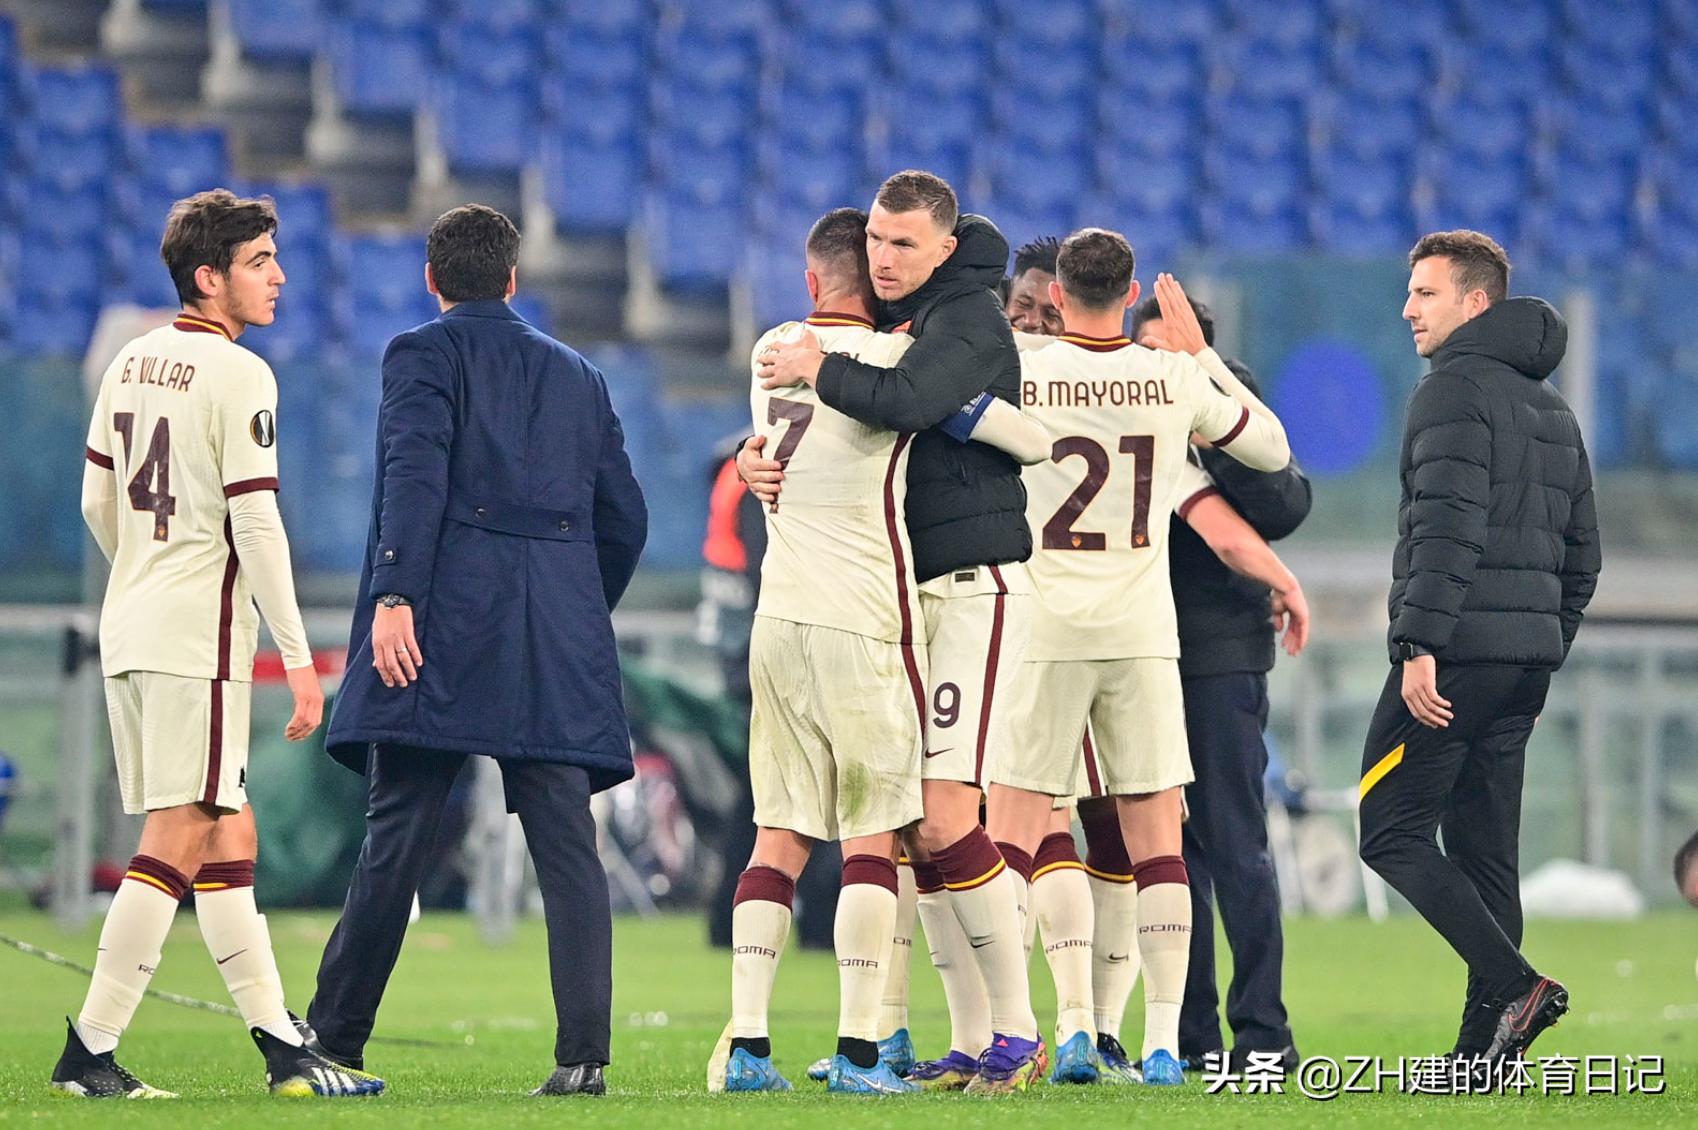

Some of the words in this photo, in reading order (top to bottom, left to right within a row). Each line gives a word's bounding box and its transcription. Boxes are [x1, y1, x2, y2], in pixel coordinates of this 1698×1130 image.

[121, 357, 135, 384] G.
[139, 356, 195, 392] VILLAR
[113, 412, 176, 542] 14
[1041, 435, 1156, 551] 21
[933, 682, 961, 728] 9
